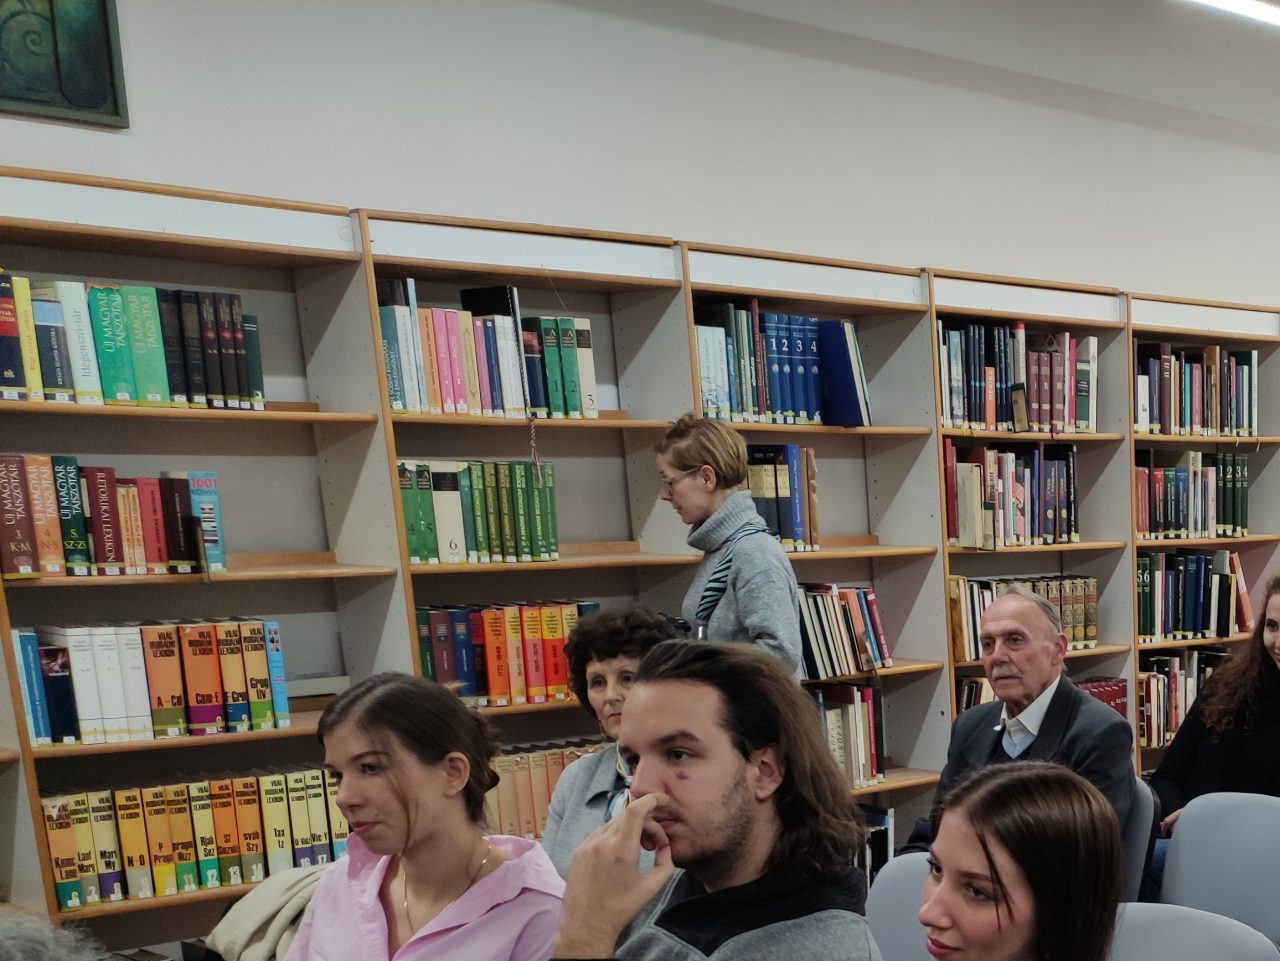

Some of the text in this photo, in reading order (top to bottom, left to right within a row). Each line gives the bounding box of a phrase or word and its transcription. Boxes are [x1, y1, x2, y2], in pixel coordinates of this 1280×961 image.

[770, 338, 776, 350] 1
[782, 339, 788, 351] 2
[796, 340, 802, 351] 3
[811, 341, 817, 352] 4
[554, 381, 559, 392] 1
[571, 381, 577, 392] 2
[588, 394, 594, 406] 3
[1227, 466, 1232, 478] 2
[1236, 466, 1241, 478] 3
[1243, 465, 1248, 478] 4
[55, 466, 70, 506] MAGYAR
[97, 472, 116, 562] RETORIKAI LEXIKON
[450, 538, 457, 550] 6
[1137, 570, 1142, 582] 5
[1144, 571, 1150, 582] 6
[153, 649, 175, 658] LEXIKON
[192, 648, 213, 656] LEXIKON
[274, 828, 285, 838] Taa
[247, 843, 259, 852] Szy
